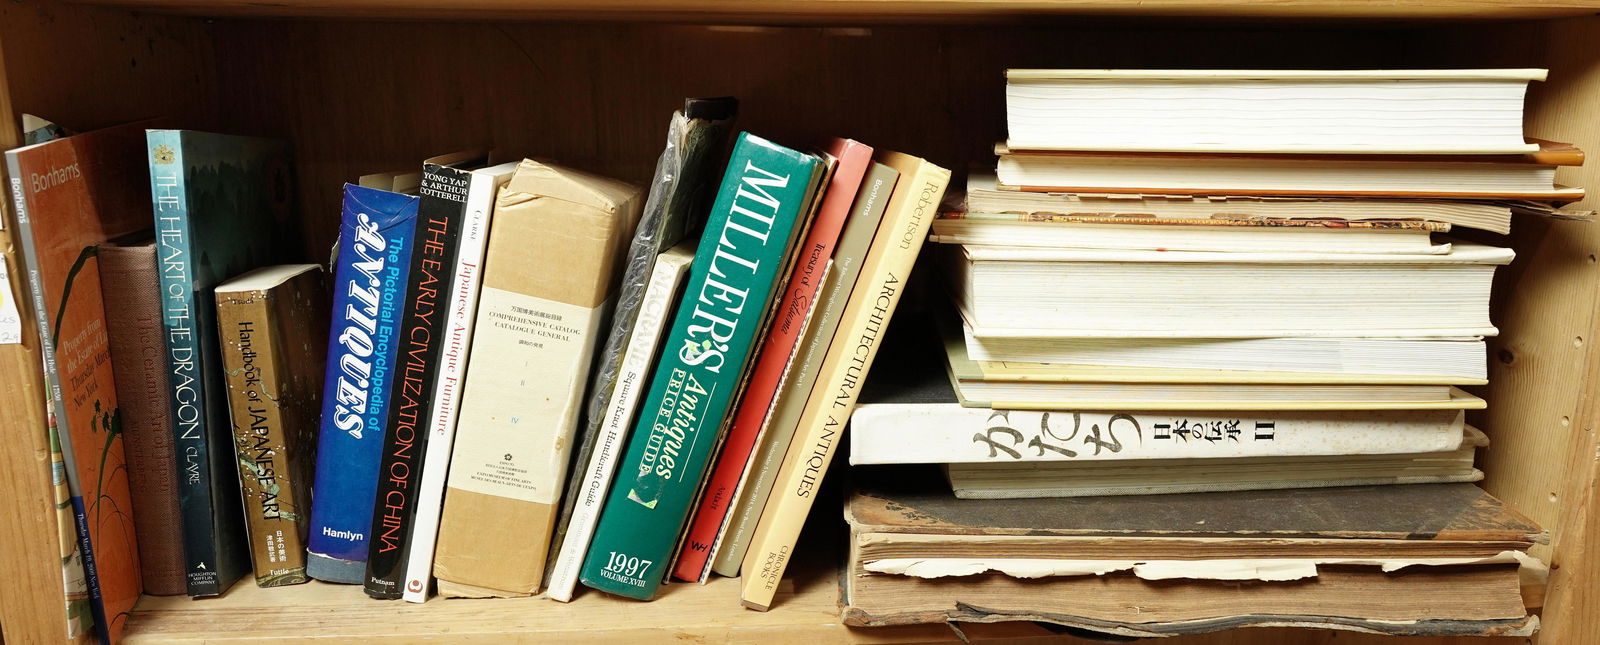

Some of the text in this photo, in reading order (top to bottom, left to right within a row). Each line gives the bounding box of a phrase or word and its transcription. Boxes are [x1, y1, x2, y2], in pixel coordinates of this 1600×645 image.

[31, 162, 81, 193] Bonhams
[421, 179, 468, 195] & ARTHUR
[424, 172, 467, 187] YONG YAP
[11, 177, 28, 224] Bonhams
[420, 186, 466, 203] COTTERELL
[863, 178, 883, 216] Bonhams
[899, 182, 939, 248] Robertson
[30, 269, 40, 294] Property
[679, 160, 791, 374] MILLER'S
[35, 295, 43, 310] from
[781, 243, 826, 335] Treasury of Satsuma
[38, 310, 47, 320] the
[40, 321, 49, 338] Estate
[137, 314, 152, 343] The
[156, 172, 201, 485] THE HEART OF THE DRAGON CLAYRE
[333, 212, 386, 439] ANTIQUES
[489, 311, 581, 335] COMPREHENSIVE CATALOG
[628, 269, 672, 367] MACRAME
[44, 338, 52, 346] of
[368, 237, 404, 432] The Pictorial Encyclopedia of
[437, 258, 476, 436] Japanese Antique Furniture
[494, 322, 570, 342] CATALOGUE GENERAL
[46, 359, 56, 374] Hyde
[141, 345, 161, 406] Ceramic
[379, 217, 448, 553] THE EARLY CIVILIZATION OF CHINA
[618, 371, 637, 408] Square
[797, 272, 899, 498] ARCHITECTURAL ANTIQUES
[238, 321, 281, 521] Handbook of JAPANESE ART
[609, 405, 625, 428] Knot
[640, 369, 685, 472] PRICE GUIDE
[656, 373, 708, 480] Antiques
[973, 409, 1142, 459] かたち
[1153, 417, 1241, 445] 日本の伝承
[585, 481, 600, 507] Guide
[276, 530, 287, 562] 日本の美術
[322, 526, 364, 542] Hamlyn
[600, 569, 646, 588] VOLUME XVIII
[604, 551, 653, 579] 1997
[760, 552, 776, 579] BOOKS
[765, 545, 788, 590] CHRONICLE
[371, 577, 395, 586] Putnam
